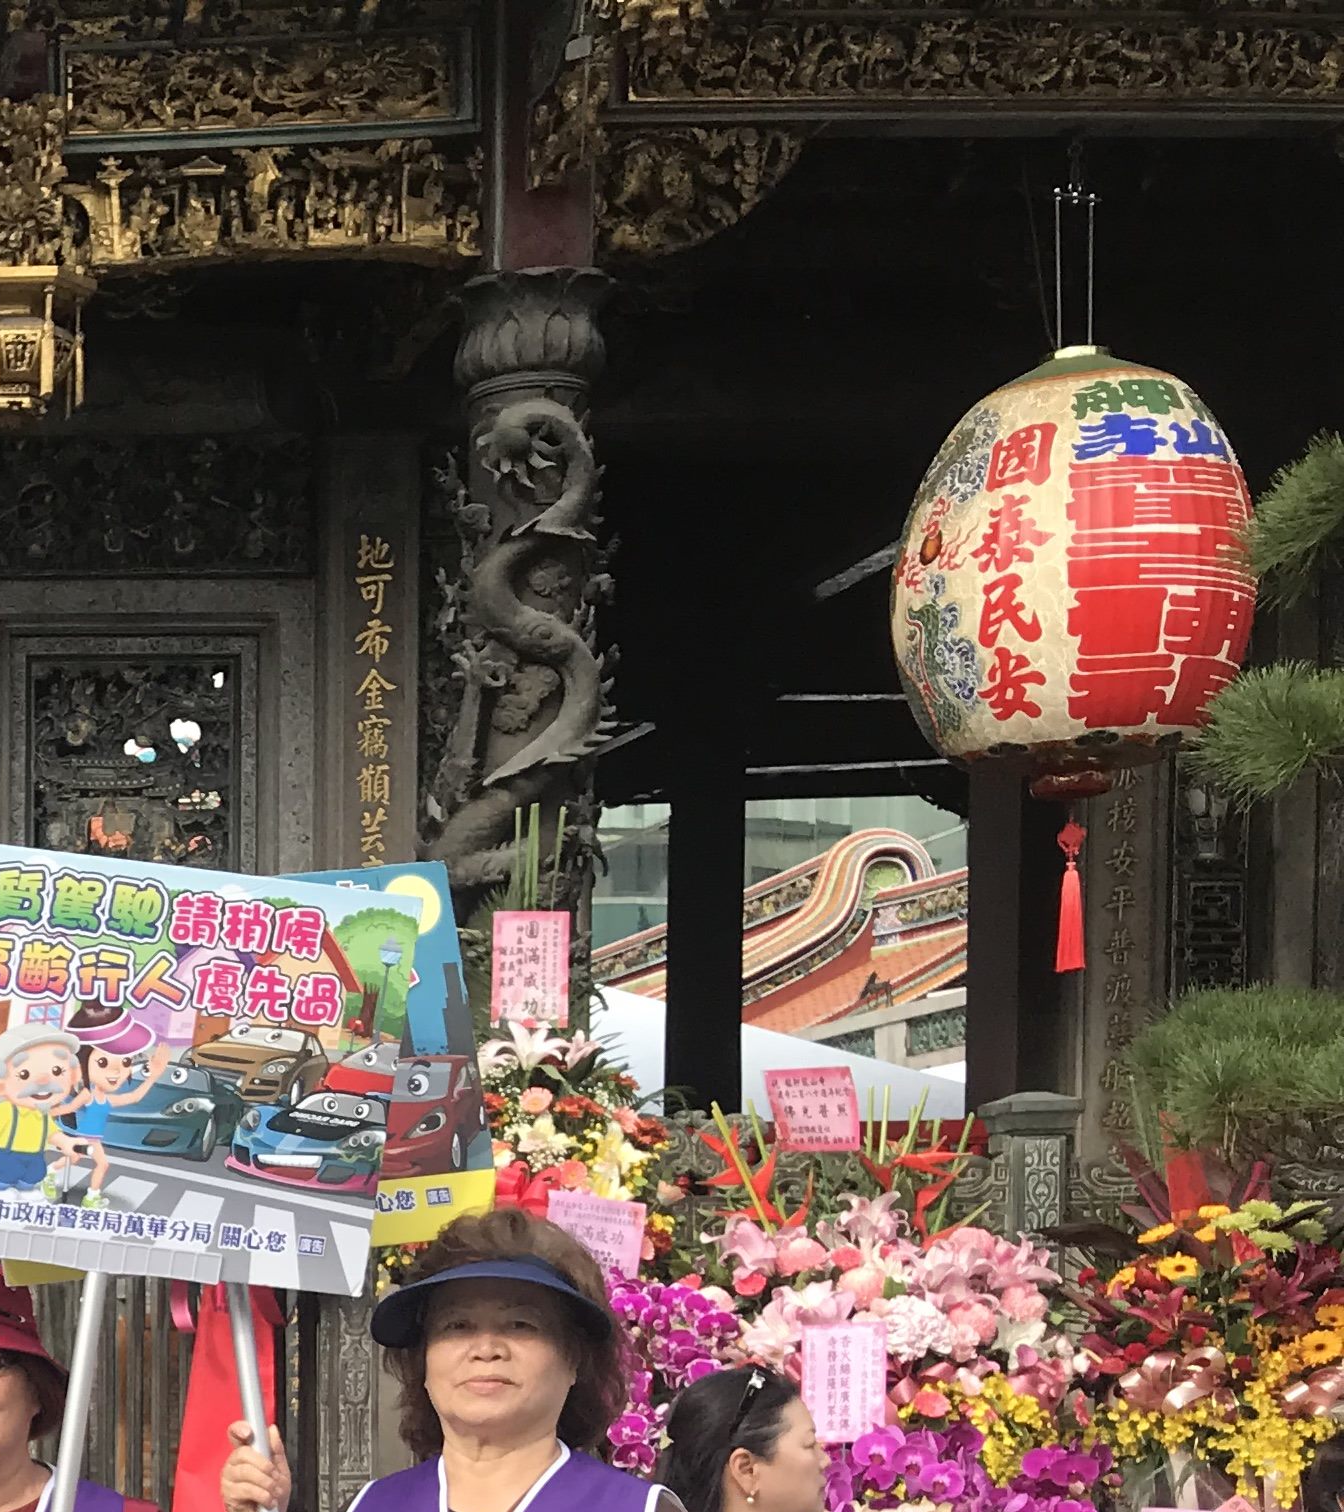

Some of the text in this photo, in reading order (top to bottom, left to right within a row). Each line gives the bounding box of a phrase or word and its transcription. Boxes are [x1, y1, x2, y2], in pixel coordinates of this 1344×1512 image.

[971, 422, 1057, 721] 國泰民安
[220, 1226, 286, 1254] 關心您
[299, 1236, 325, 1255] 廣告
